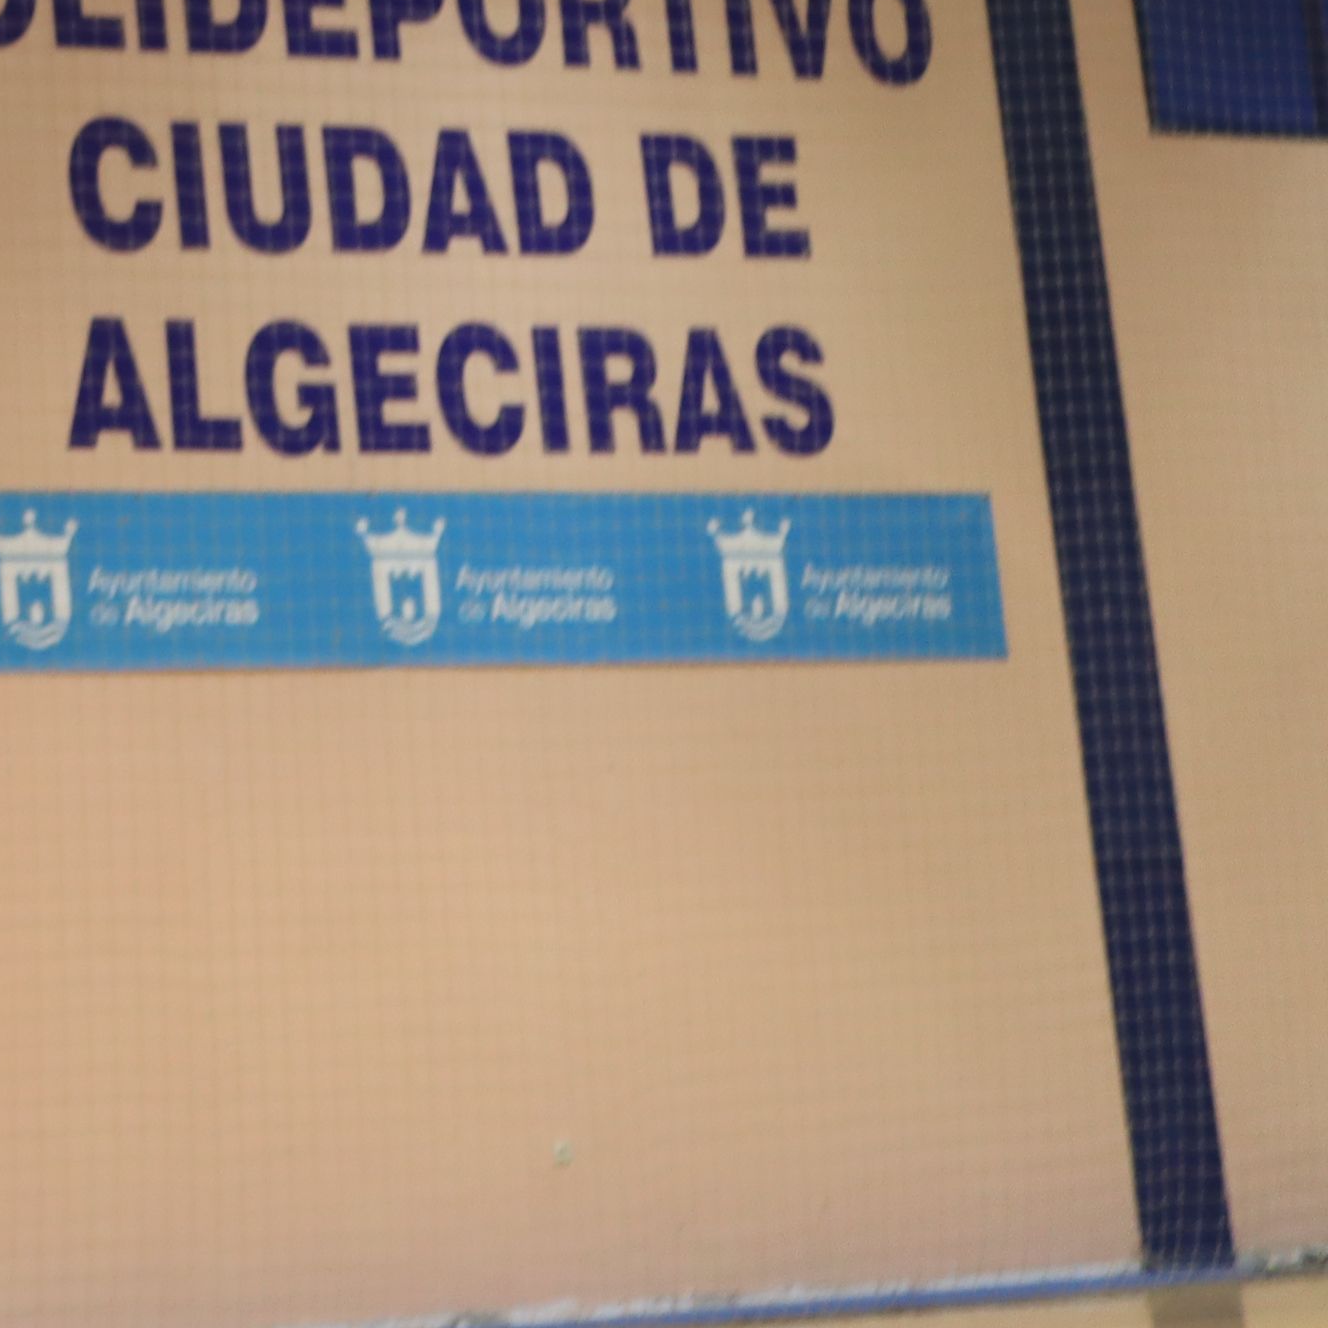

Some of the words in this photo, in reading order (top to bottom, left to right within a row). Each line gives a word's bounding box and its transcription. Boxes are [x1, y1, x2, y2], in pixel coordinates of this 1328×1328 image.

[67, 114, 595, 256] CIUDAD
[639, 132, 812, 259] DE
[68, 317, 835, 458] ALGECIRAS
[124, 594, 259, 635] Algeciras
